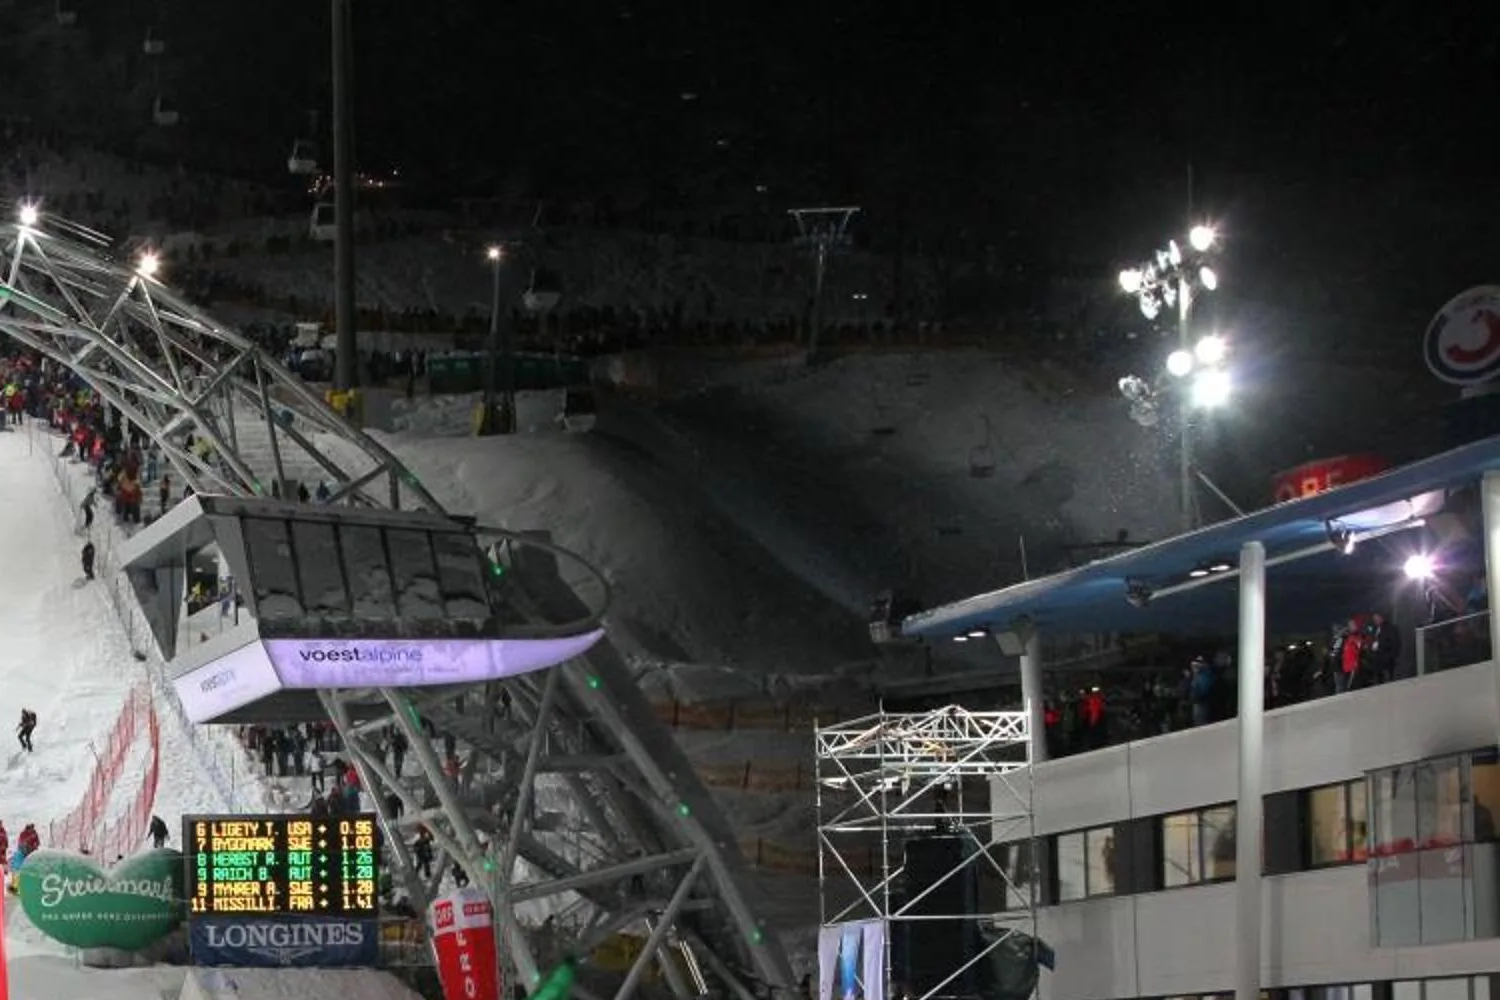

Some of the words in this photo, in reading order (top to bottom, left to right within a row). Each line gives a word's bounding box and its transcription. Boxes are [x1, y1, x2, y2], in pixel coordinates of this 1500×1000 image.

[299, 644, 423, 667] voestalpine
[196, 822, 206, 837] 6
[287, 821, 313, 836] USA
[197, 838, 206, 851] 7
[288, 837, 313, 850] SWE
[288, 852, 313, 865] AUT
[197, 867, 207, 881] 9
[213, 867, 253, 880] RAICH
[288, 867, 313, 880] AUT
[197, 882, 207, 897] 9
[289, 881, 313, 896] SWE
[191, 897, 207, 912] 11
[289, 896, 314, 910] FRA
[343, 895, 373, 910] 1.41
[205, 923, 364, 948] LONGINES
